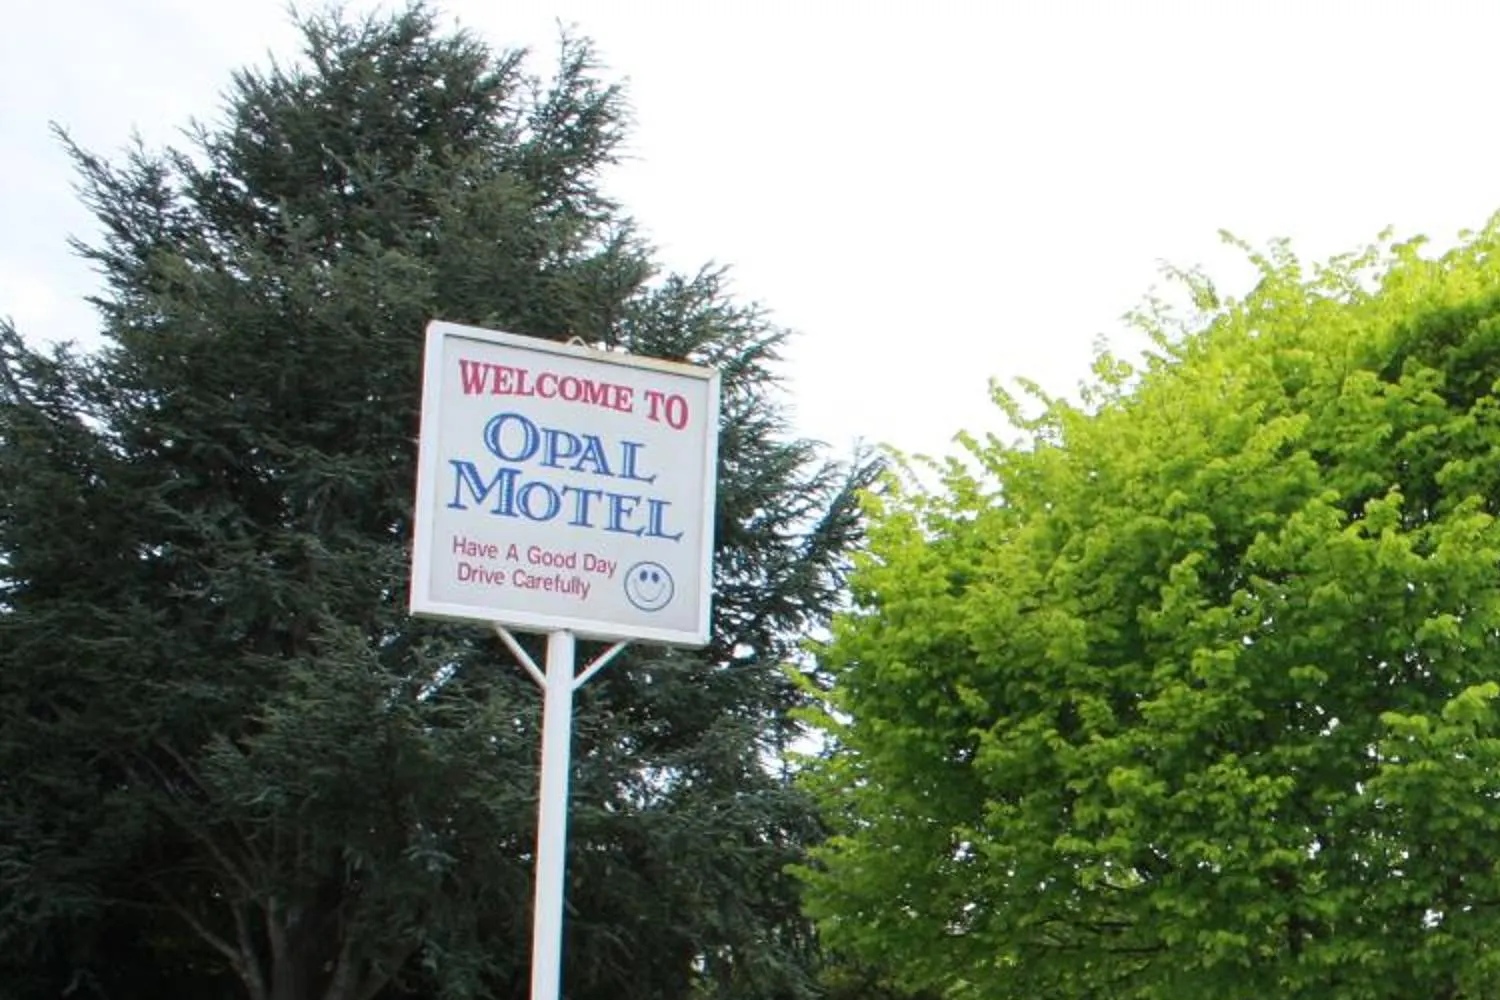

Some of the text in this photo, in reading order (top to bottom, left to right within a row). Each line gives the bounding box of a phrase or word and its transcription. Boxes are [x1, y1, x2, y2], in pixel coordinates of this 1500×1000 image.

[459, 358, 688, 430] WELCOME TO
[483, 412, 657, 485] OPAL
[447, 459, 684, 542] MOTEL
[453, 535, 617, 579] Have A Good Day
[457, 562, 591, 600] Drive Carefully
